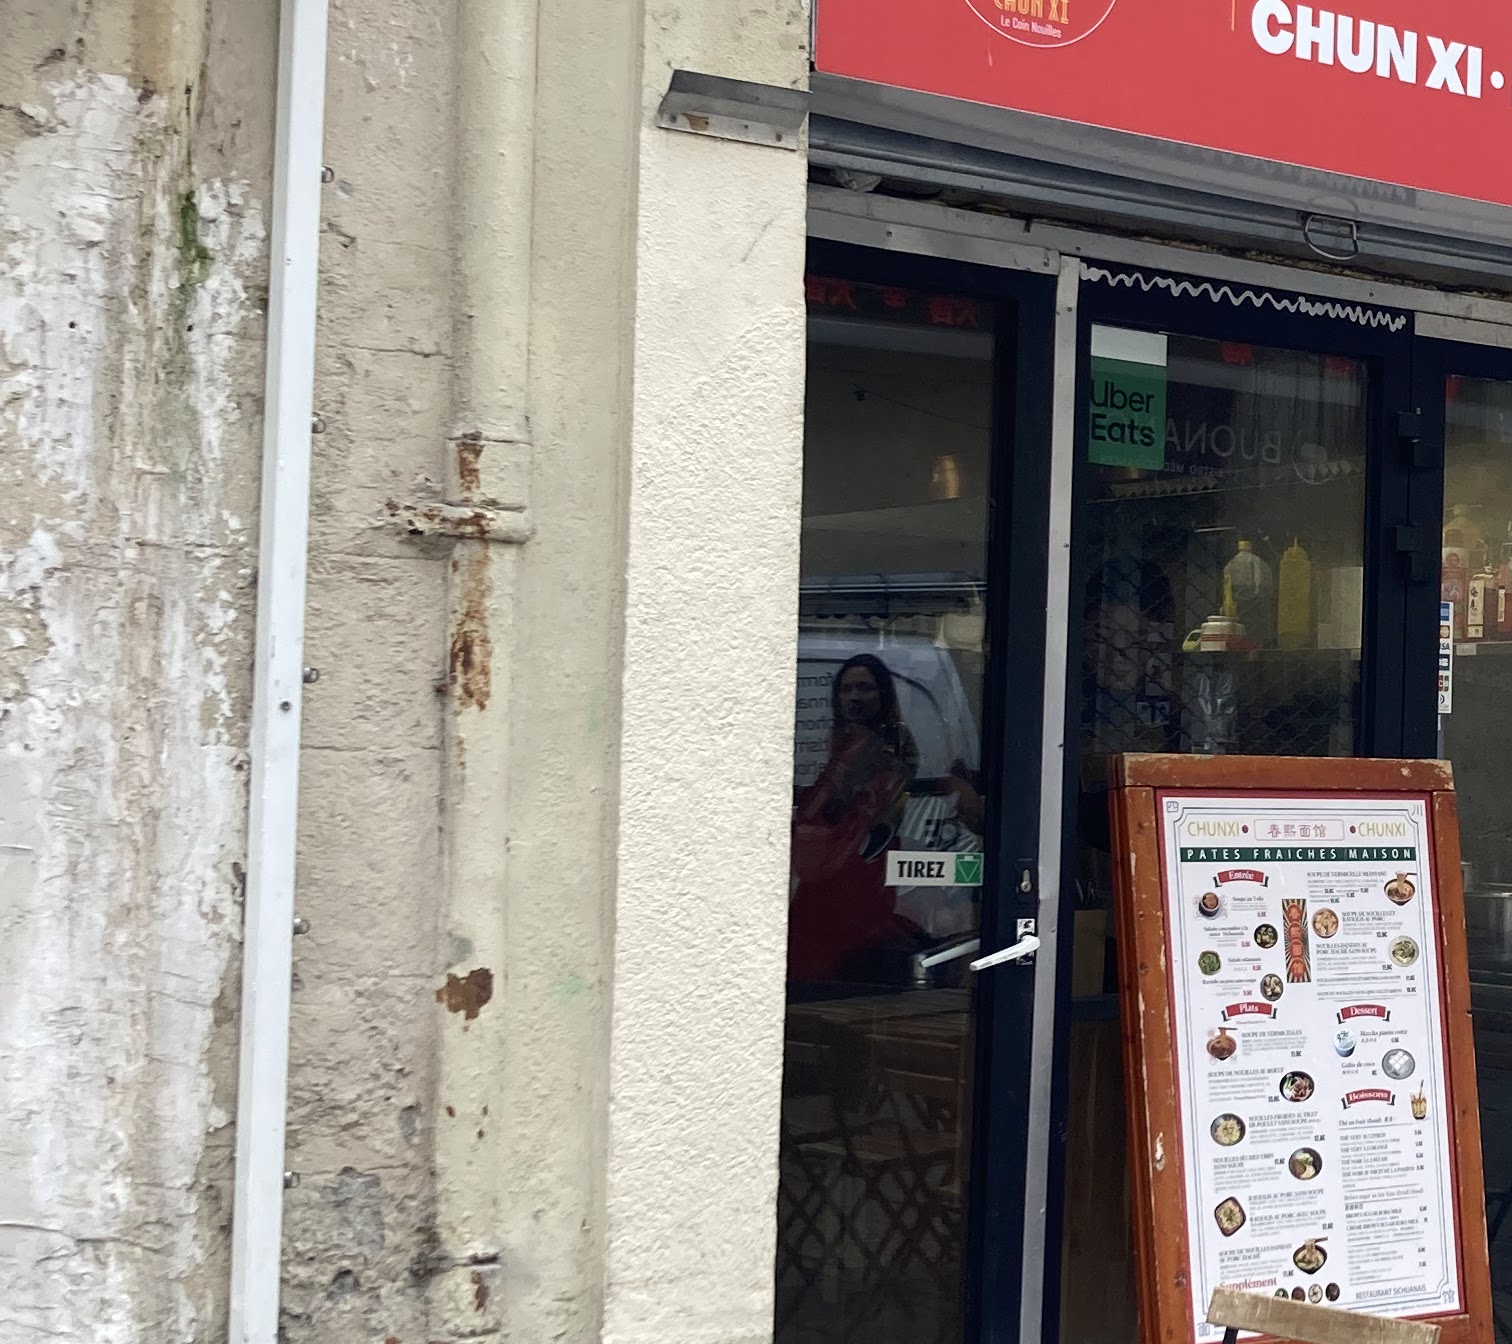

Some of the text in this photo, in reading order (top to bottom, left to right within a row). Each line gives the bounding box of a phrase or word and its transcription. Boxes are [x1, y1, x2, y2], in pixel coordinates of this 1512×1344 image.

[1000, 14, 1062, 39] Le Coin Nouilles
[1425, 35, 1483, 98] XI
[1089, 379, 1155, 415] Uber
[1090, 412, 1156, 447] Eats
[1187, 821, 1240, 837] CHUNXI
[1358, 821, 1406, 837] CHUNXI
[1187, 848, 1411, 860] PATES FRAICHES MAISON
[896, 860, 946, 879] TIREZ
[1228, 870, 1255, 881] Entrée
[1240, 1002, 1259, 1013] Plats
[1350, 1006, 1378, 1016] Dessert
